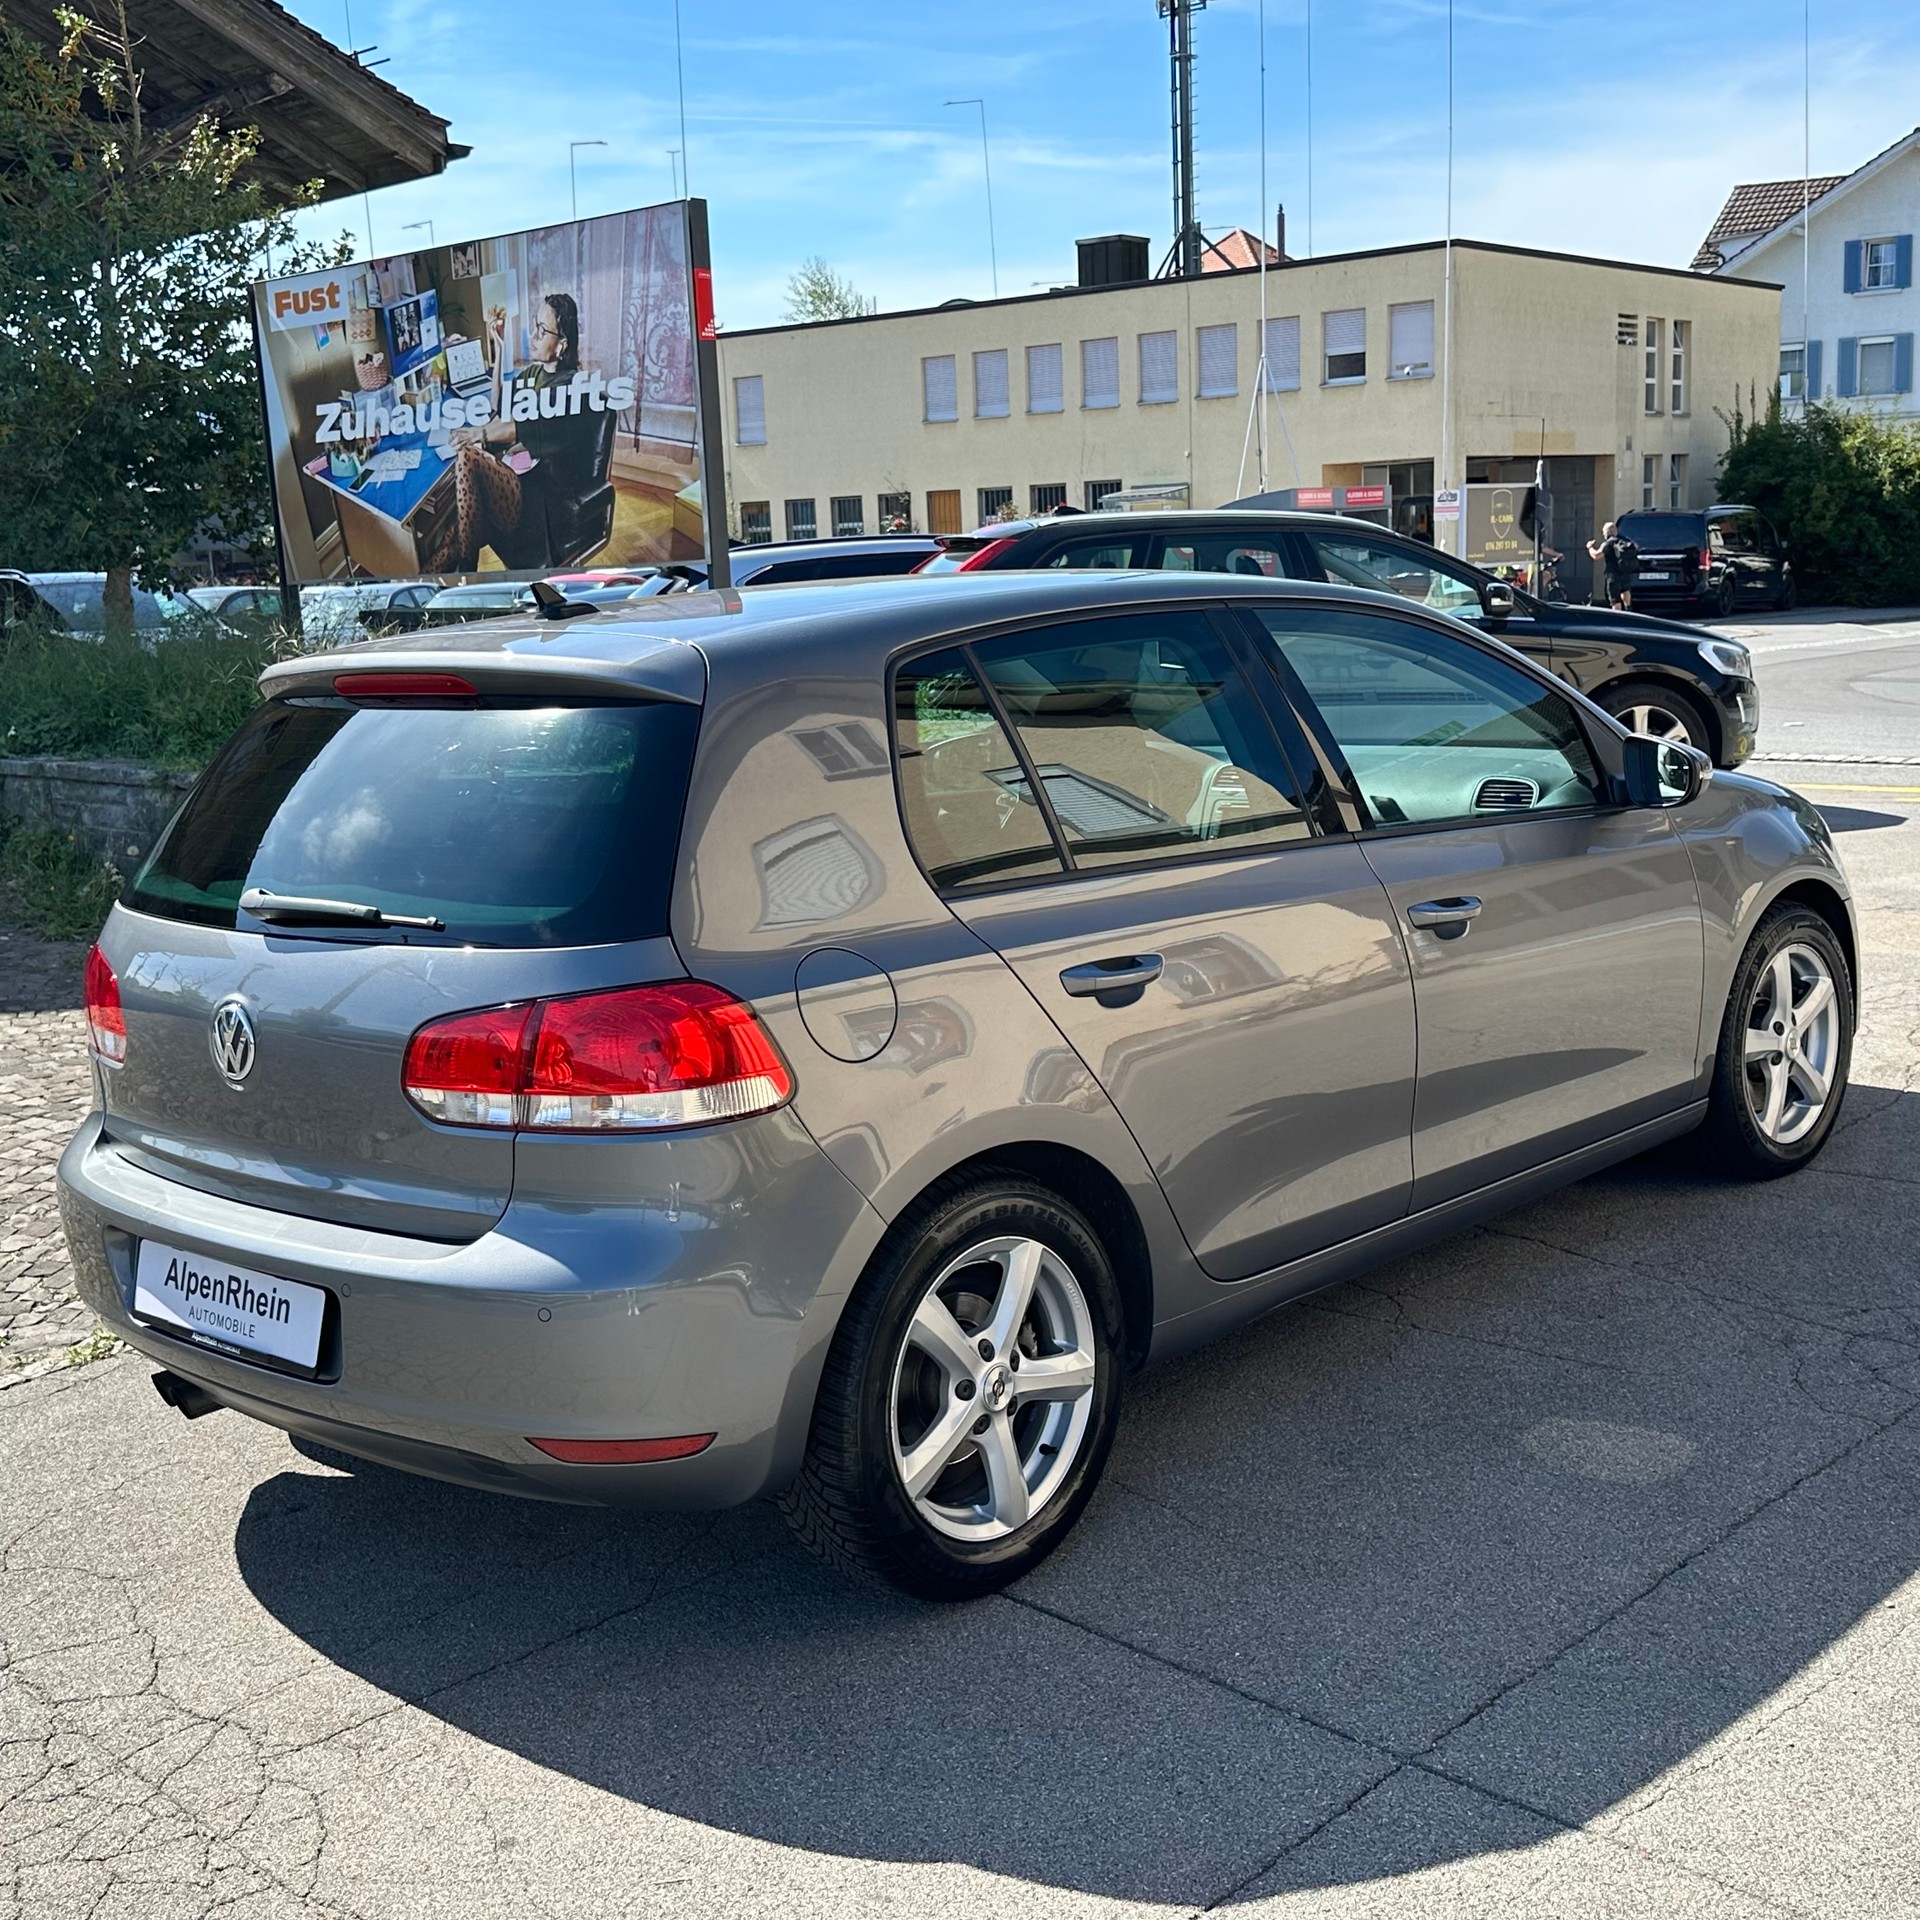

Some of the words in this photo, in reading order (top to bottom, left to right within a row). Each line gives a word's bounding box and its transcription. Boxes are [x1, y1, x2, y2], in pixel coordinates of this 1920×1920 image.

[274, 281, 340, 318] Fust
[315, 395, 491, 443] Zuhause
[500, 369, 635, 423] läufts
[164, 1257, 290, 1324] AlpenRhein
[188, 1305, 256, 1339] AUTOMOBILE
